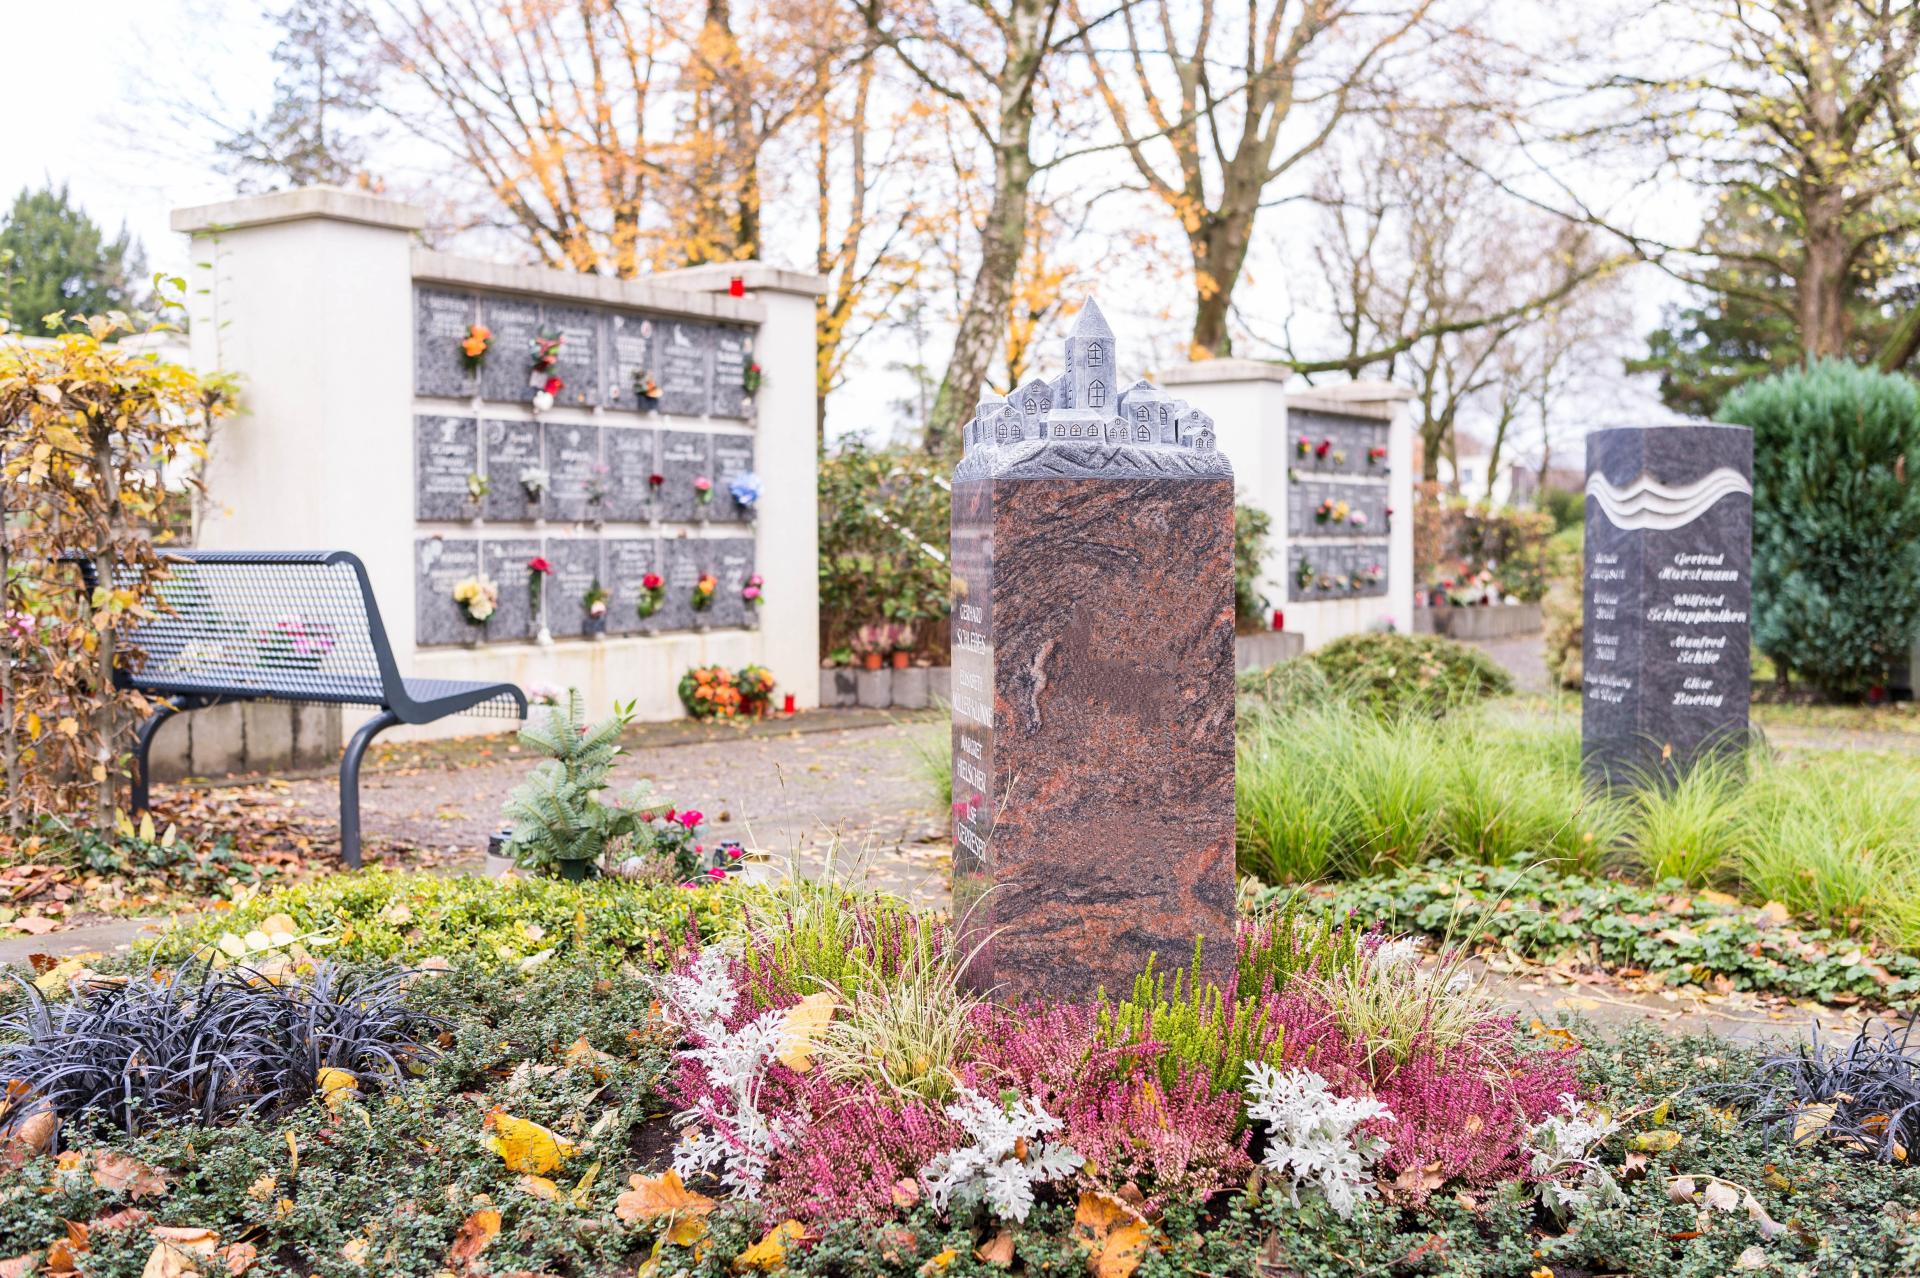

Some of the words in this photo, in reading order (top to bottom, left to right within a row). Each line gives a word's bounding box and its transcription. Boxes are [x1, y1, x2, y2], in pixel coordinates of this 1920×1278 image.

[1674, 552, 1724, 566] Gertrud
[1672, 593, 1725, 607] Wilfried
[1670, 635, 1726, 648] Manfred
[957, 758, 987, 793] HIELSCHER
